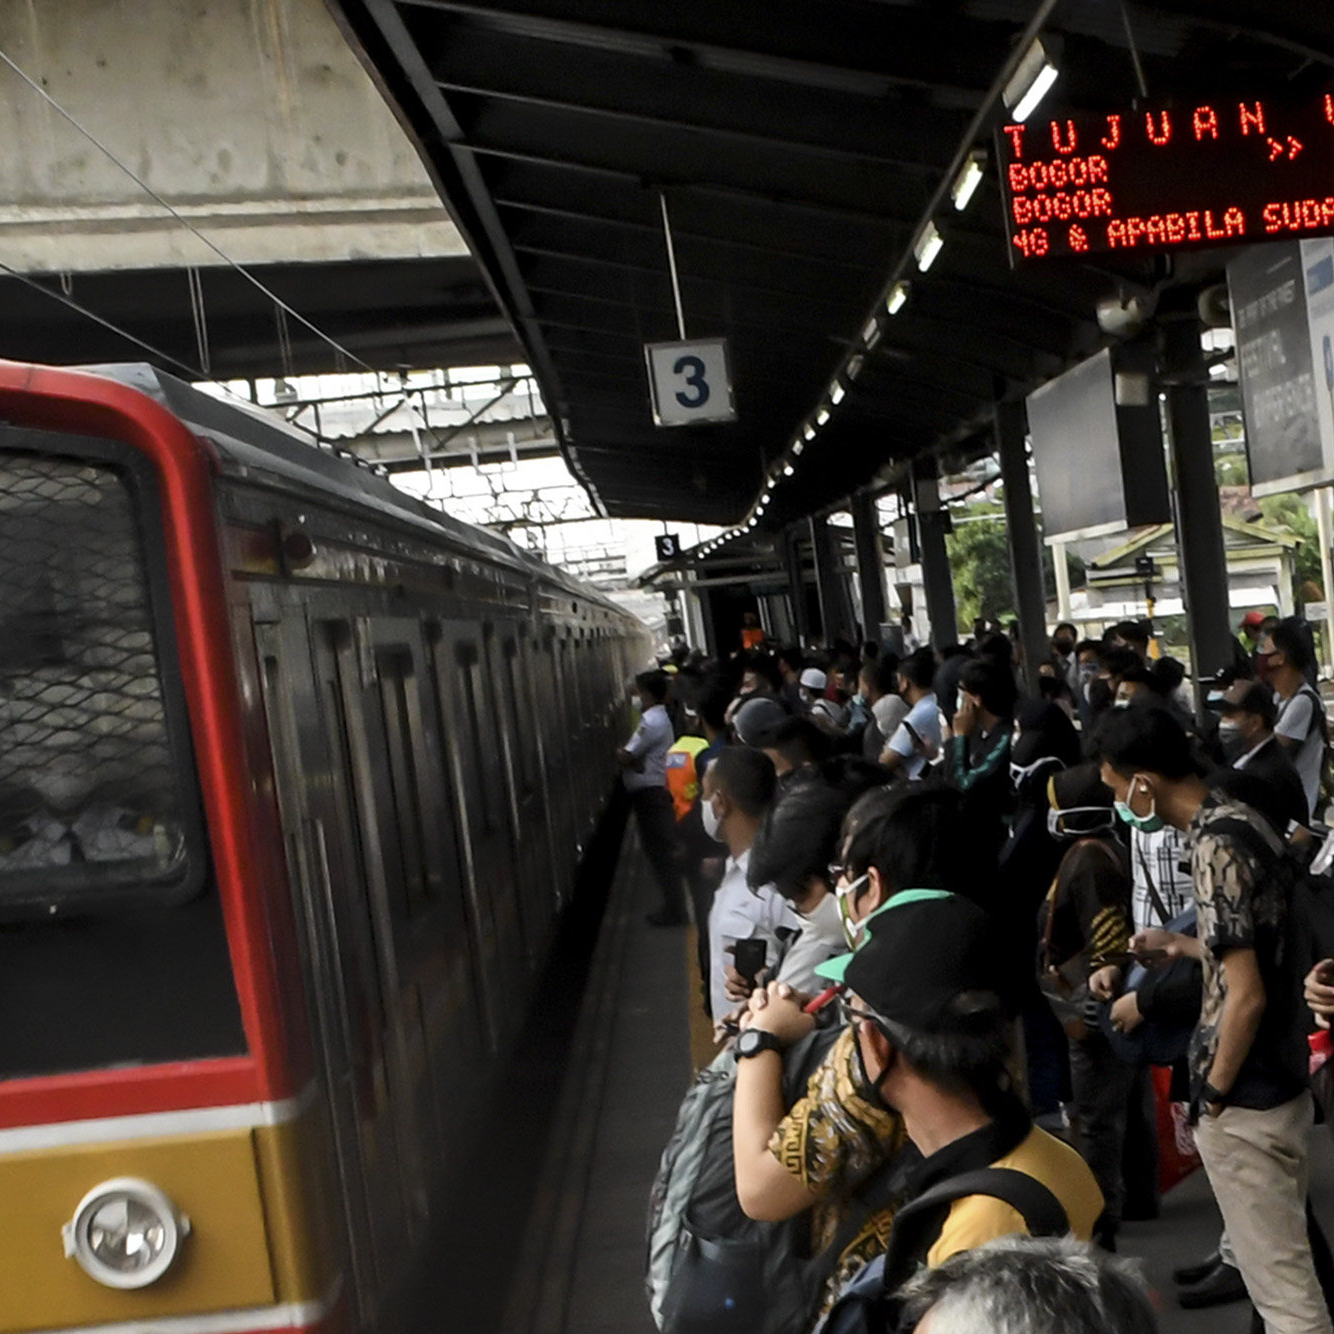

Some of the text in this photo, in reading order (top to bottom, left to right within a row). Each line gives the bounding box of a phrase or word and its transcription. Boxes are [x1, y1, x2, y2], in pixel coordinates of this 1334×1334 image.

[1009, 154, 1108, 191] BOGOR
[1013, 187, 1111, 224] BOGOR
[1107, 206, 1245, 248] APABILA
[673, 355, 710, 409] 3
[662, 538, 674, 556] 3
